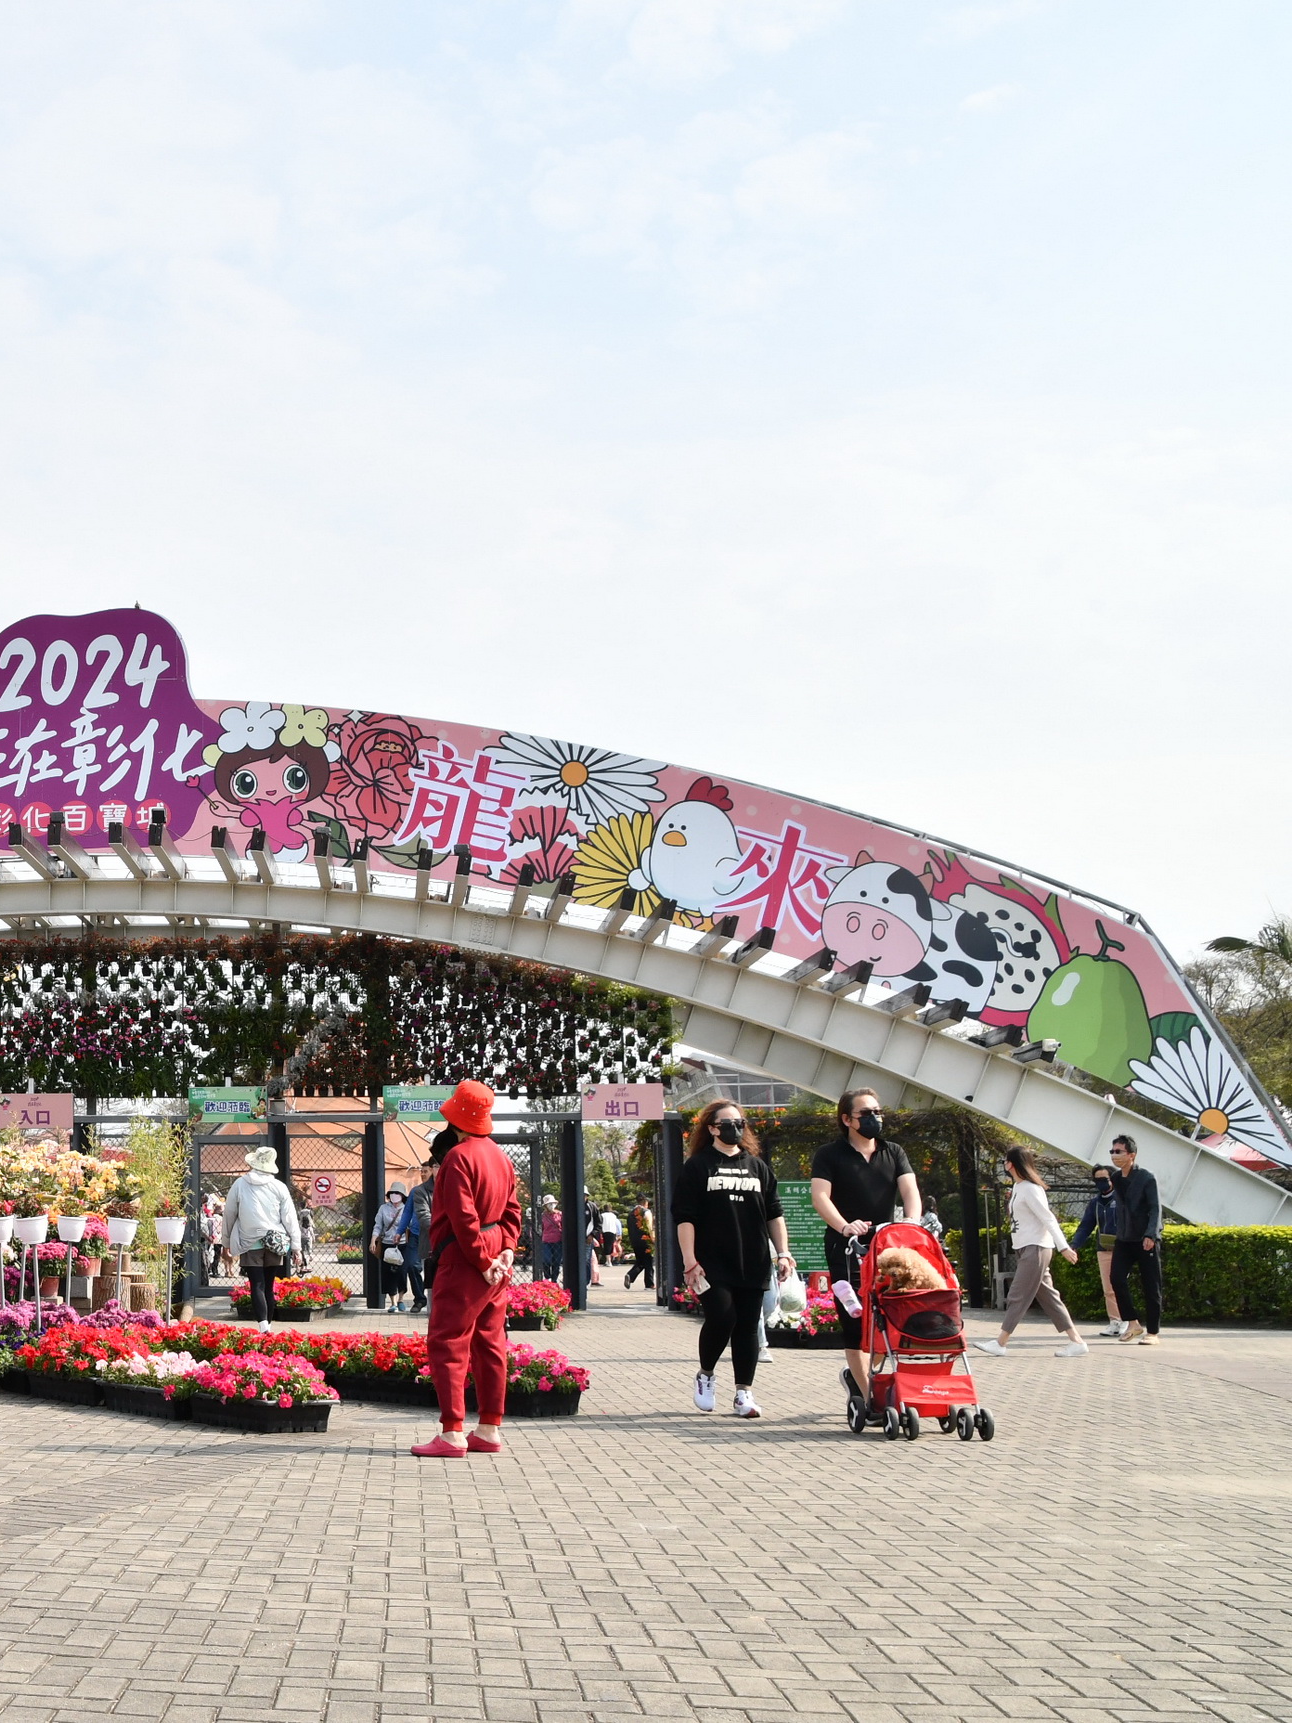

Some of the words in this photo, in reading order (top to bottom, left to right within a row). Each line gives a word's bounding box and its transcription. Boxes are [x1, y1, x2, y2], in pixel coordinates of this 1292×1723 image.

[394, 741, 528, 865] 龍
[713, 821, 846, 939] 來
[604, 1100, 639, 1116] 出口
[18, 1109, 50, 1125] 入口
